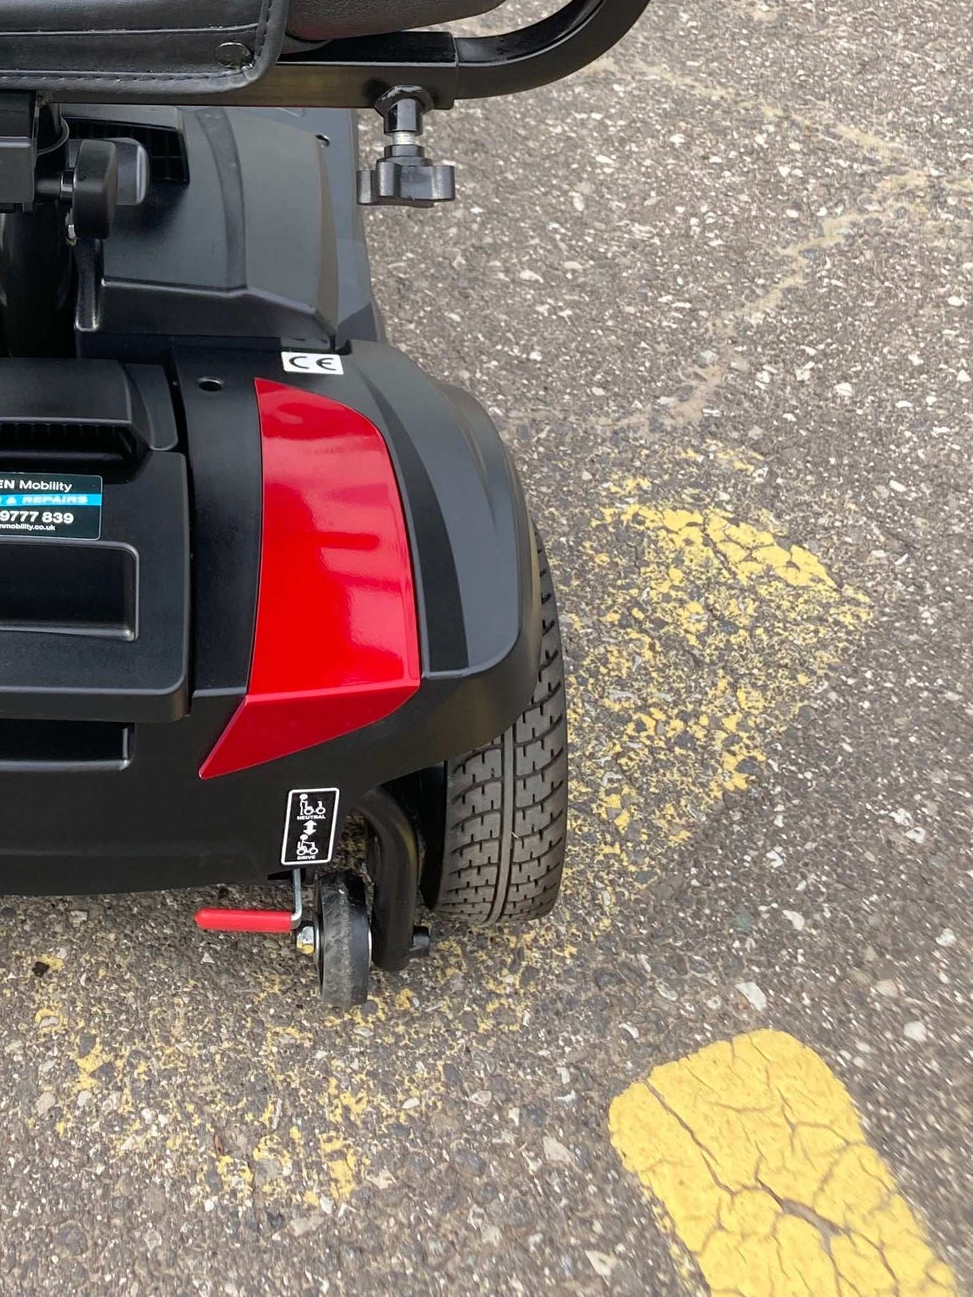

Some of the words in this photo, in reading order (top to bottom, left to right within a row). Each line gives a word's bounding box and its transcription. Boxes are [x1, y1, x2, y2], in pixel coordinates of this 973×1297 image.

[19, 480, 72, 492] Mobility
[22, 495, 88, 504] REPAIRS
[0, 511, 39, 522] 9777
[42, 511, 75, 524] 839
